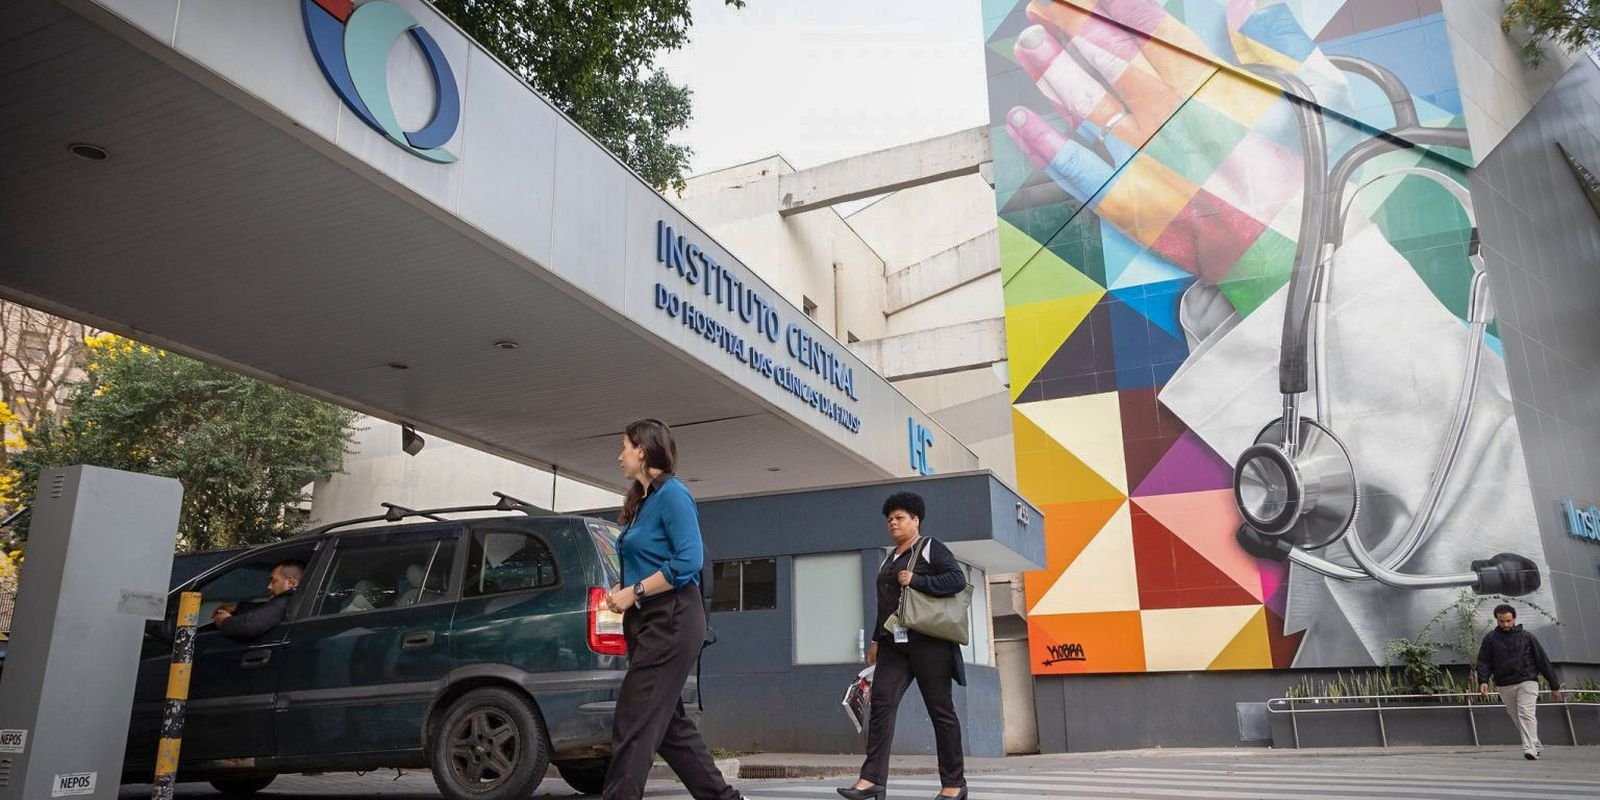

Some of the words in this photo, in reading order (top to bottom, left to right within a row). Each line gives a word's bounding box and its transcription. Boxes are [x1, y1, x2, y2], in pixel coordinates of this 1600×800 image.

[657, 219, 780, 344] INSTITUTO
[786, 321, 859, 401] CENTRAL
[655, 282, 680, 318] DO
[682, 300, 748, 363] HOSPITAL
[749, 347, 773, 379] DAS
[773, 365, 819, 408] CLÍNICAS
[819, 393, 833, 418] DA
[908, 416, 935, 477] HC
[1045, 643, 1085, 660] KOBRA
[0, 733, 22, 745] NEPOS
[60, 776, 91, 789] NEPOS
